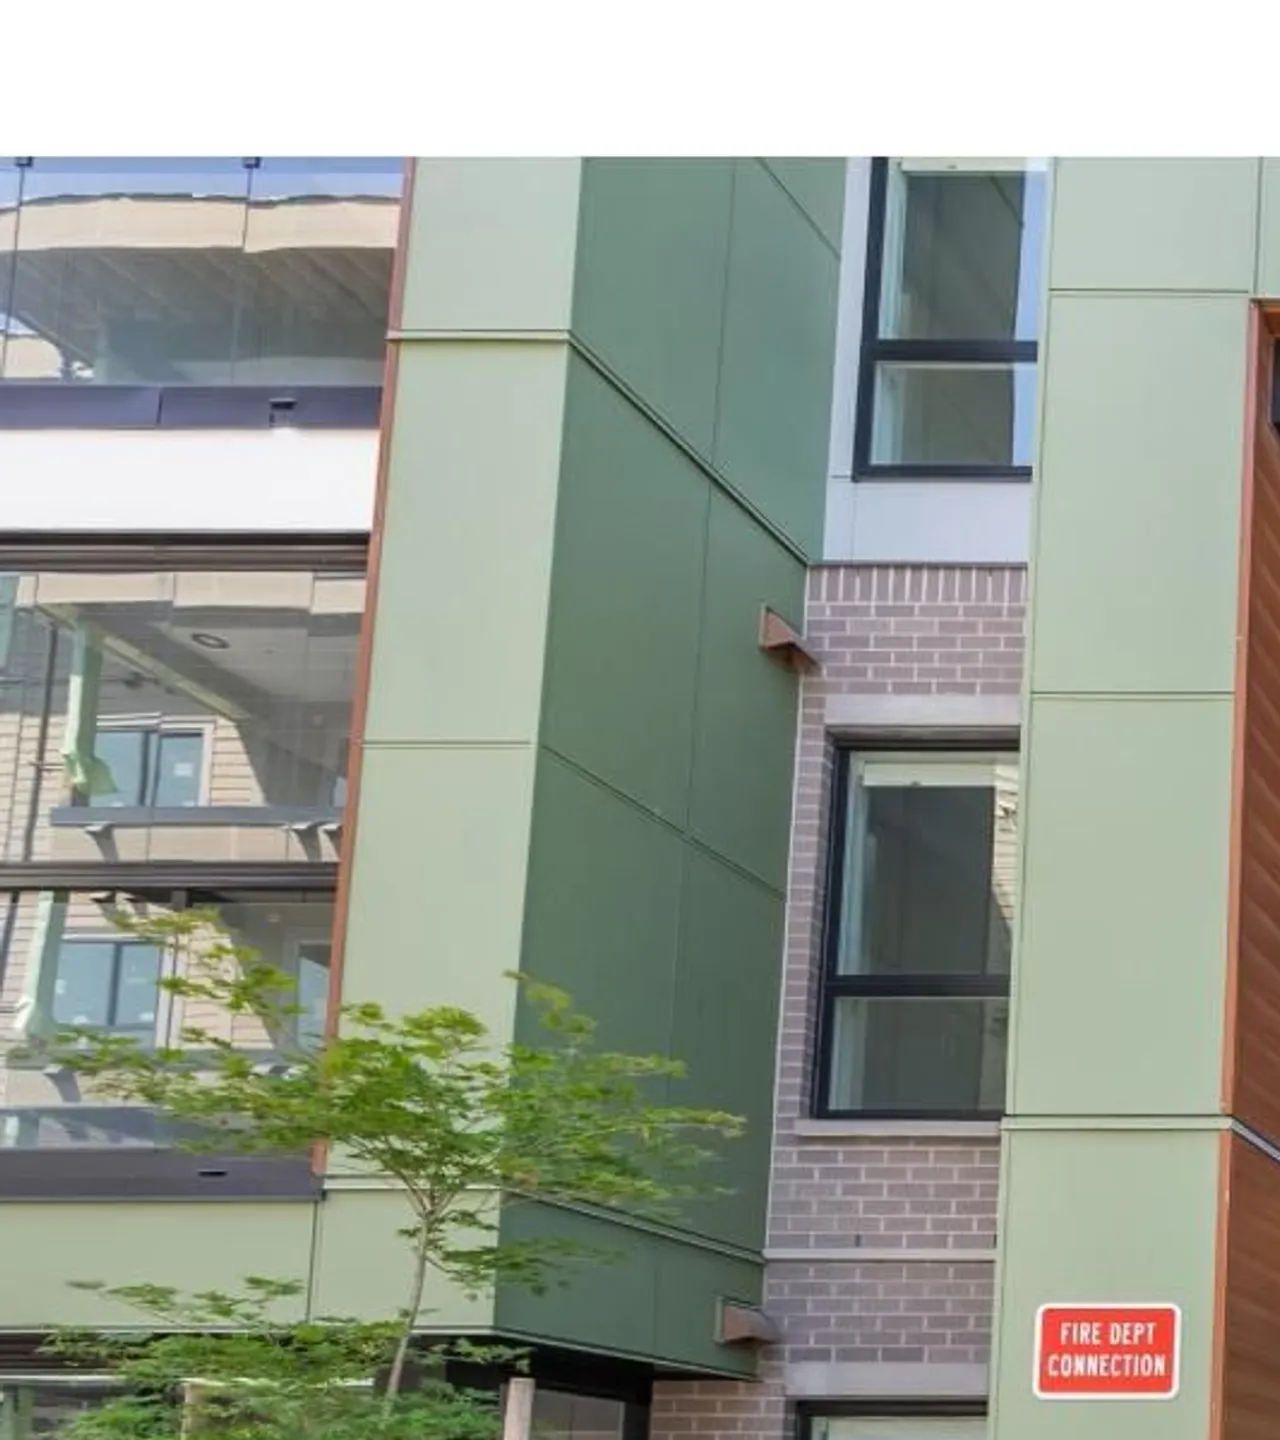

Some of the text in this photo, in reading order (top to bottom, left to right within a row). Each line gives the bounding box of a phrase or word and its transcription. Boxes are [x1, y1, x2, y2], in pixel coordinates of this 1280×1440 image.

[1060, 1322, 1157, 1345] FIRE DEPT
[1048, 1353, 1166, 1377] CONNECTION
